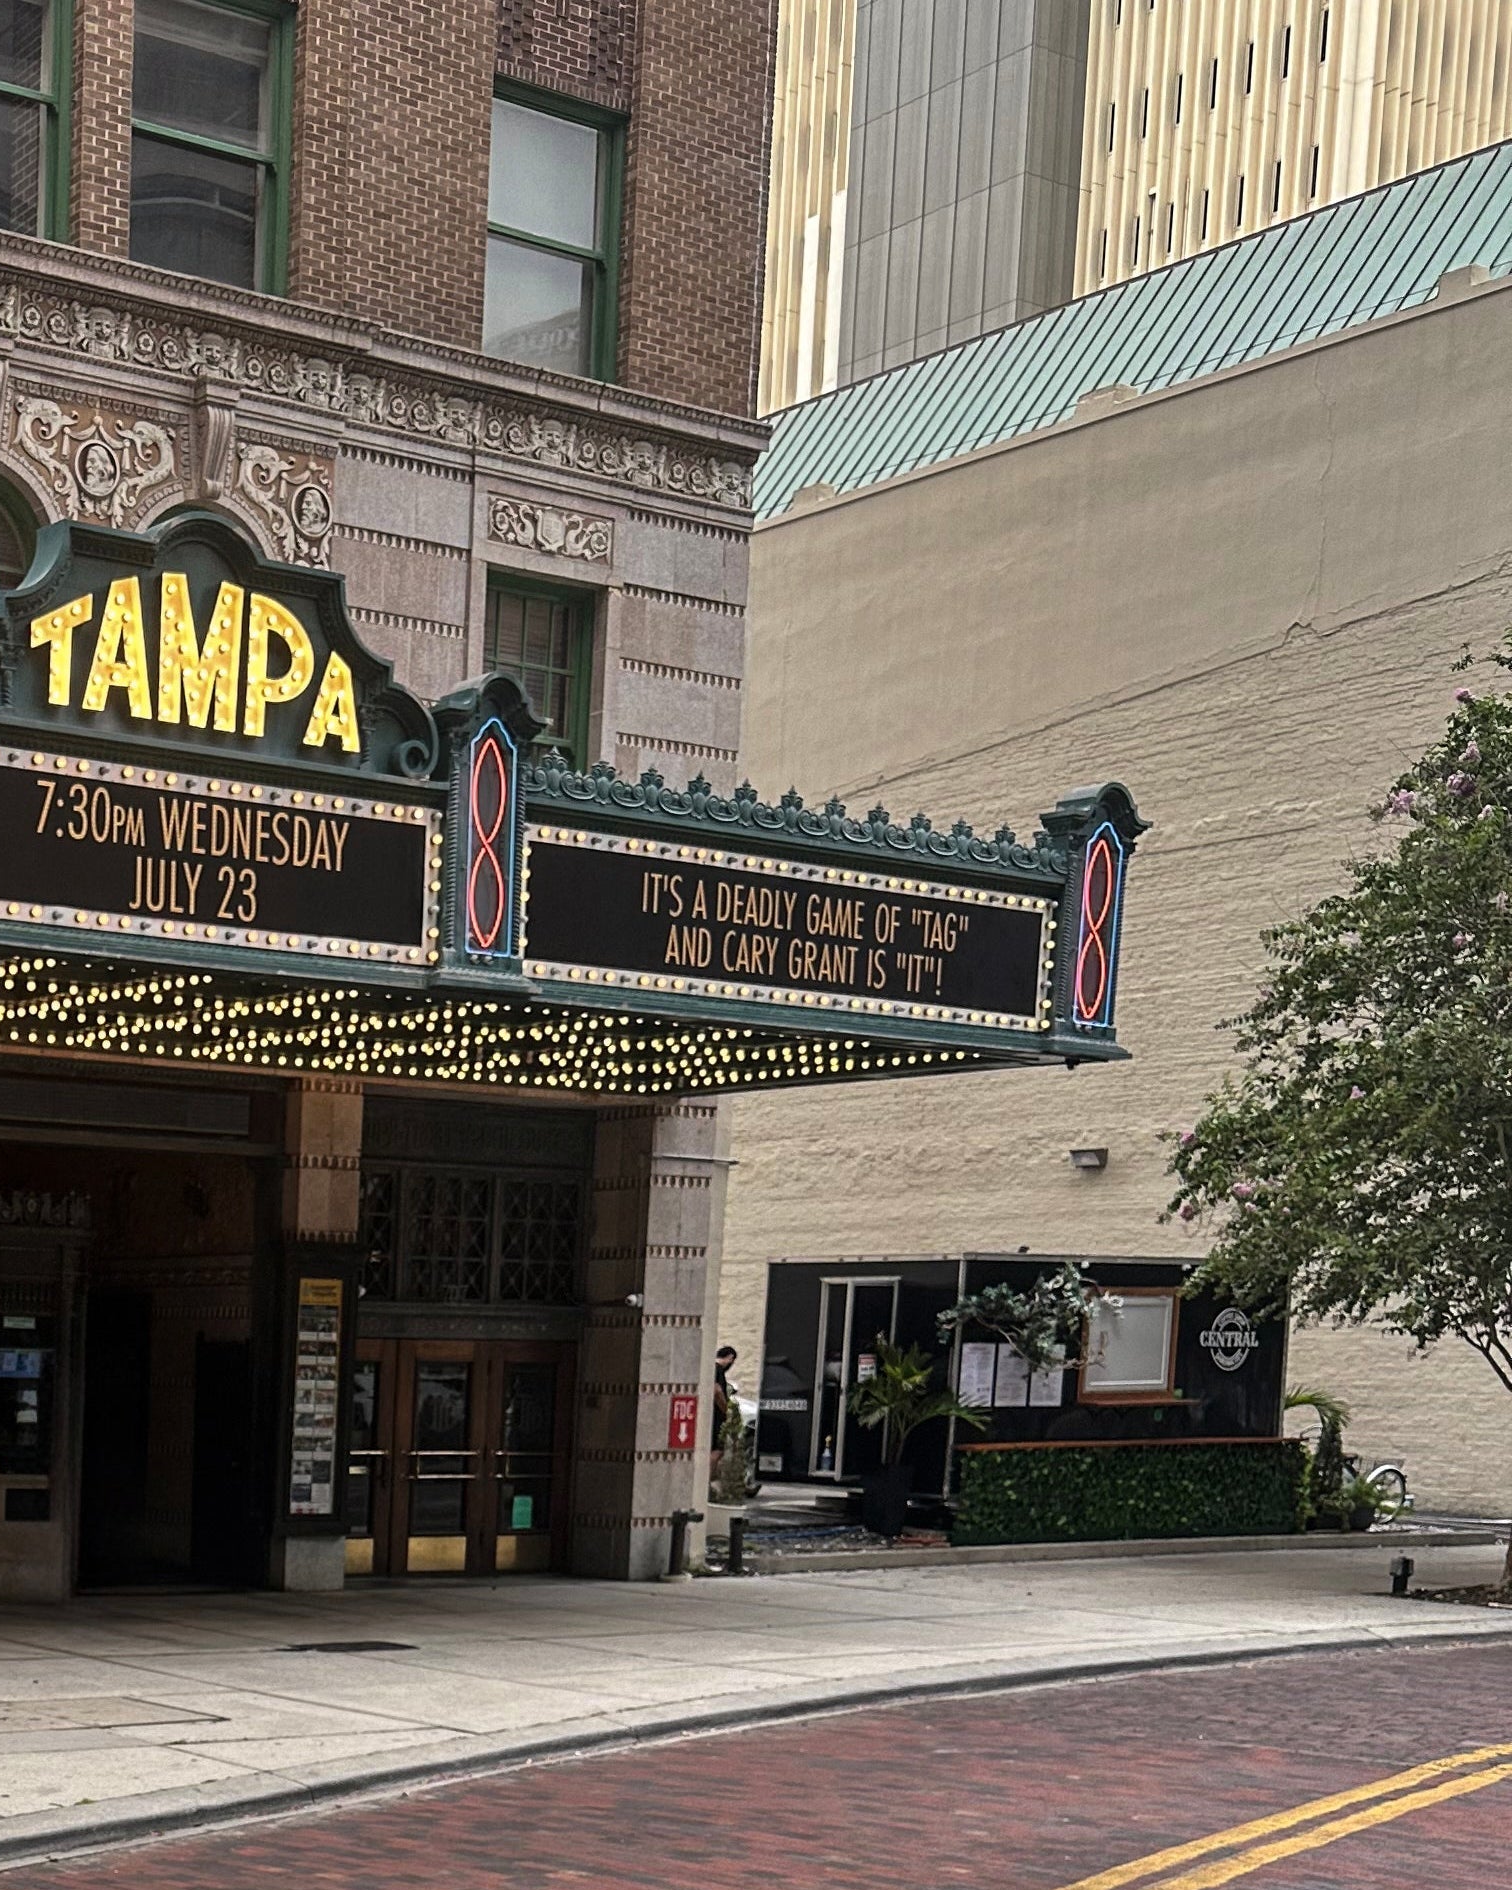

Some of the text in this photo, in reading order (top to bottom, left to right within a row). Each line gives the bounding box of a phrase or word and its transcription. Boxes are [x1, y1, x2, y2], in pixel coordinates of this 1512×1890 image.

[30, 571, 361, 753] TAMPA
[35, 779, 351, 872] 7:30PM WEDNESDAY
[128, 855, 258, 923] JULY 23
[642, 871, 969, 952] IT'S A DEADLY GAME OF "TAG"
[664, 925, 943, 996] AND CARY GRANT IS "IT"!
[1199, 1331, 1259, 1348] CENTRAL
[673, 1400, 695, 1420] FDC
